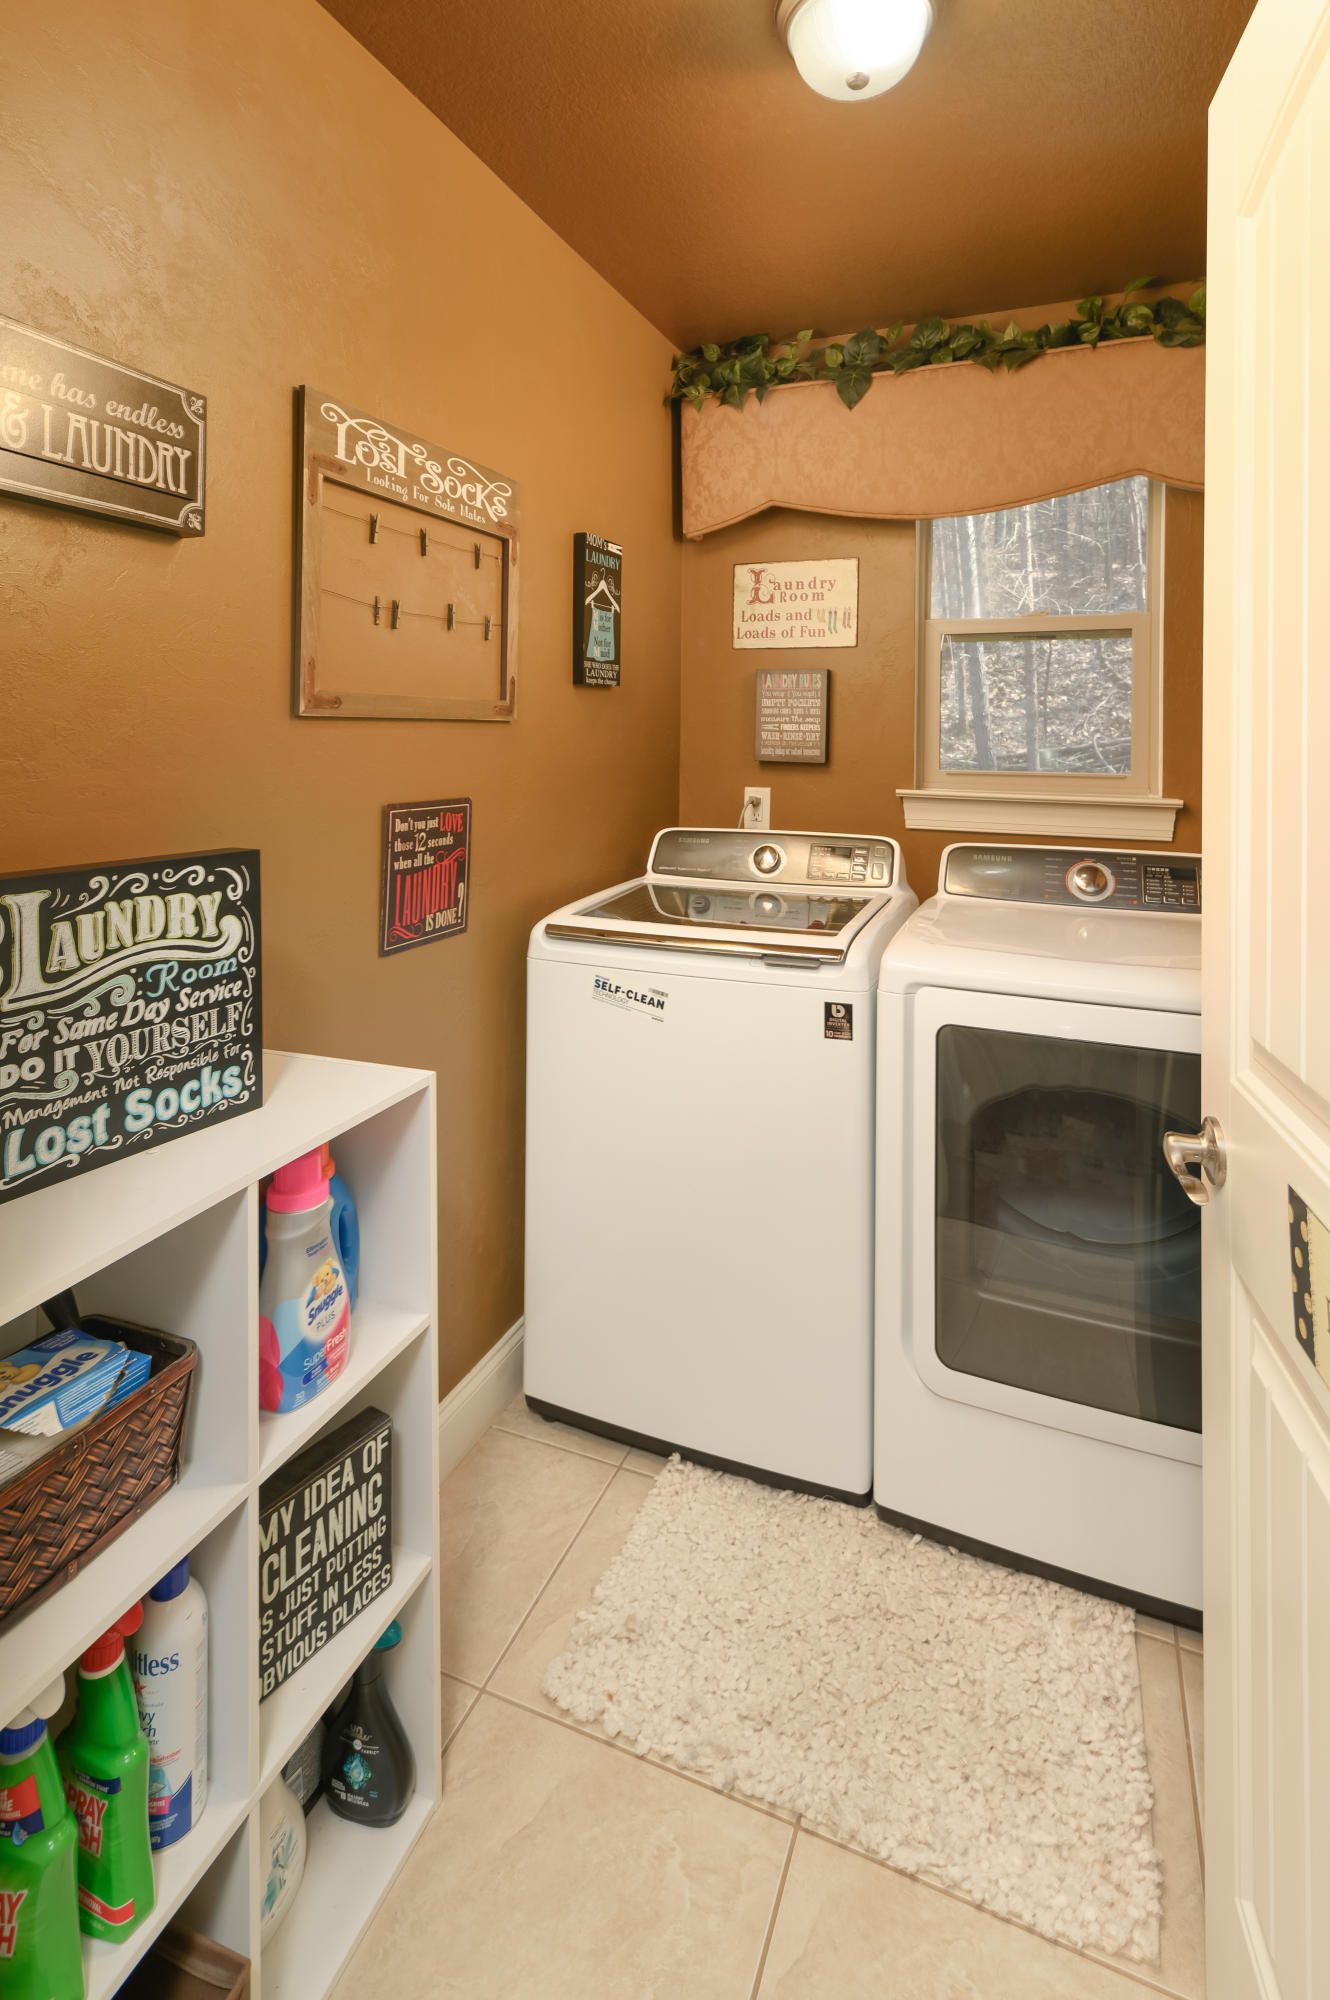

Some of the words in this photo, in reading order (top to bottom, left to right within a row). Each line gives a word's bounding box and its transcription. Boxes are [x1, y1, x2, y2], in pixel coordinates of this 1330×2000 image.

[50, 372, 96, 408] has
[105, 400, 185, 439] endless
[1, 392, 29, 448] &
[41, 403, 192, 494] LAUNDRY
[320, 402, 428, 479] LOST
[366, 467, 409, 501] Looking
[413, 485, 430, 504] For
[435, 495, 456, 513] Sole
[460, 503, 487, 524] Mates
[585, 549, 620, 571] LAUNDRY
[746, 567, 836, 605] Laundry
[736, 626, 776, 640] Loads
[781, 625, 796, 638] of
[800, 625, 826, 638] Fun
[741, 609, 781, 623] Loads
[785, 608, 812, 621] and
[586, 668, 618, 680] LAUNDRY
[394, 838, 414, 852] those
[414, 832, 427, 852] 12
[427, 832, 454, 848] seconds
[395, 816, 413, 833] Don't
[414, 819, 425, 833] you
[426, 816, 439, 832] just
[440, 811, 464, 833] LOVE
[394, 855, 412, 871] when
[413, 852, 423, 868] all
[424, 852, 435, 866] the
[973, 854, 1013, 863] SAMSUNG
[395, 860, 458, 927] LAUNDRY
[0, 889, 223, 1006] LAUNDRY
[425, 914, 434, 932] IS
[145, 956, 238, 998] Room
[594, 978, 665, 1010] SELF-CLEAN
[0, 1028, 49, 1060] For
[53, 1010, 118, 1045] Same
[121, 998, 170, 1029] Day
[175, 978, 242, 1012] Service
[0, 1056, 46, 1090] DO
[53, 1044, 81, 1074] IT
[84, 1000, 243, 1074] YOURSELF
[2, 1085, 108, 1130] Management
[113, 1075, 141, 1095] Not
[145, 1049, 219, 1085] Responsible
[223, 1042, 241, 1059] For
[308, 1285, 343, 1326] Snuggle
[259, 1498, 296, 1552] MY
[304, 1457, 355, 1521] IDEA
[362, 1428, 390, 1475] OF
[262, 1472, 383, 1605] CLEANING
[279, 1567, 321, 1621] JUST
[325, 1514, 387, 1585] PUTTING
[262, 1598, 318, 1668] STUFF
[323, 1583, 339, 1614] IN
[343, 1545, 383, 1598] LESS
[332, 1563, 392, 1635] PLACES
[62, 1777, 108, 1828] PRAY
